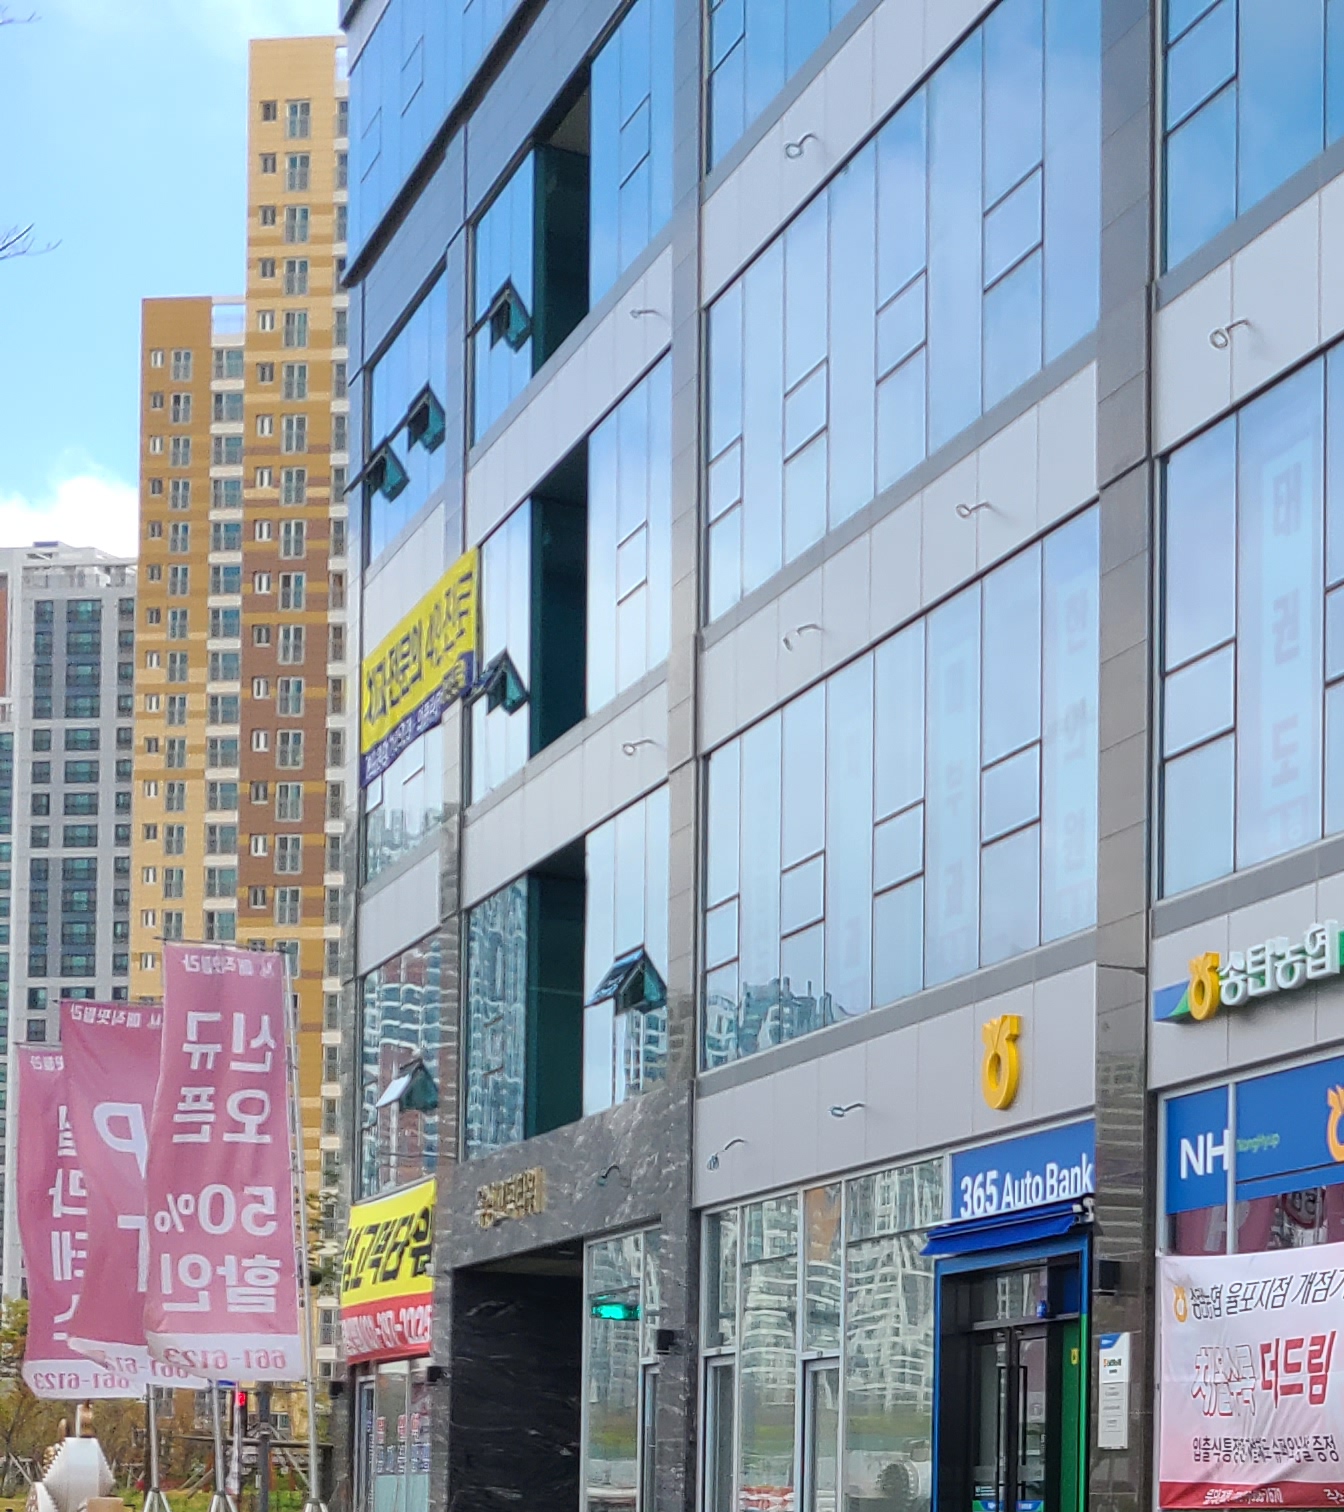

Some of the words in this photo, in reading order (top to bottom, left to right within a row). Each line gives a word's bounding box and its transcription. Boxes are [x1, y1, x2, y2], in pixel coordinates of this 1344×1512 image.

[1218, 917, 1341, 1007] 송탄농협
[1180, 1130, 1230, 1181] NH
[960, 1170, 999, 1219] 365
[1000, 1171, 1044, 1211] Auto
[1045, 1152, 1095, 1200] Bank
[1226, 1275, 1293, 1316] 율포지점
[1312, 1432, 1340, 1464] 증정
